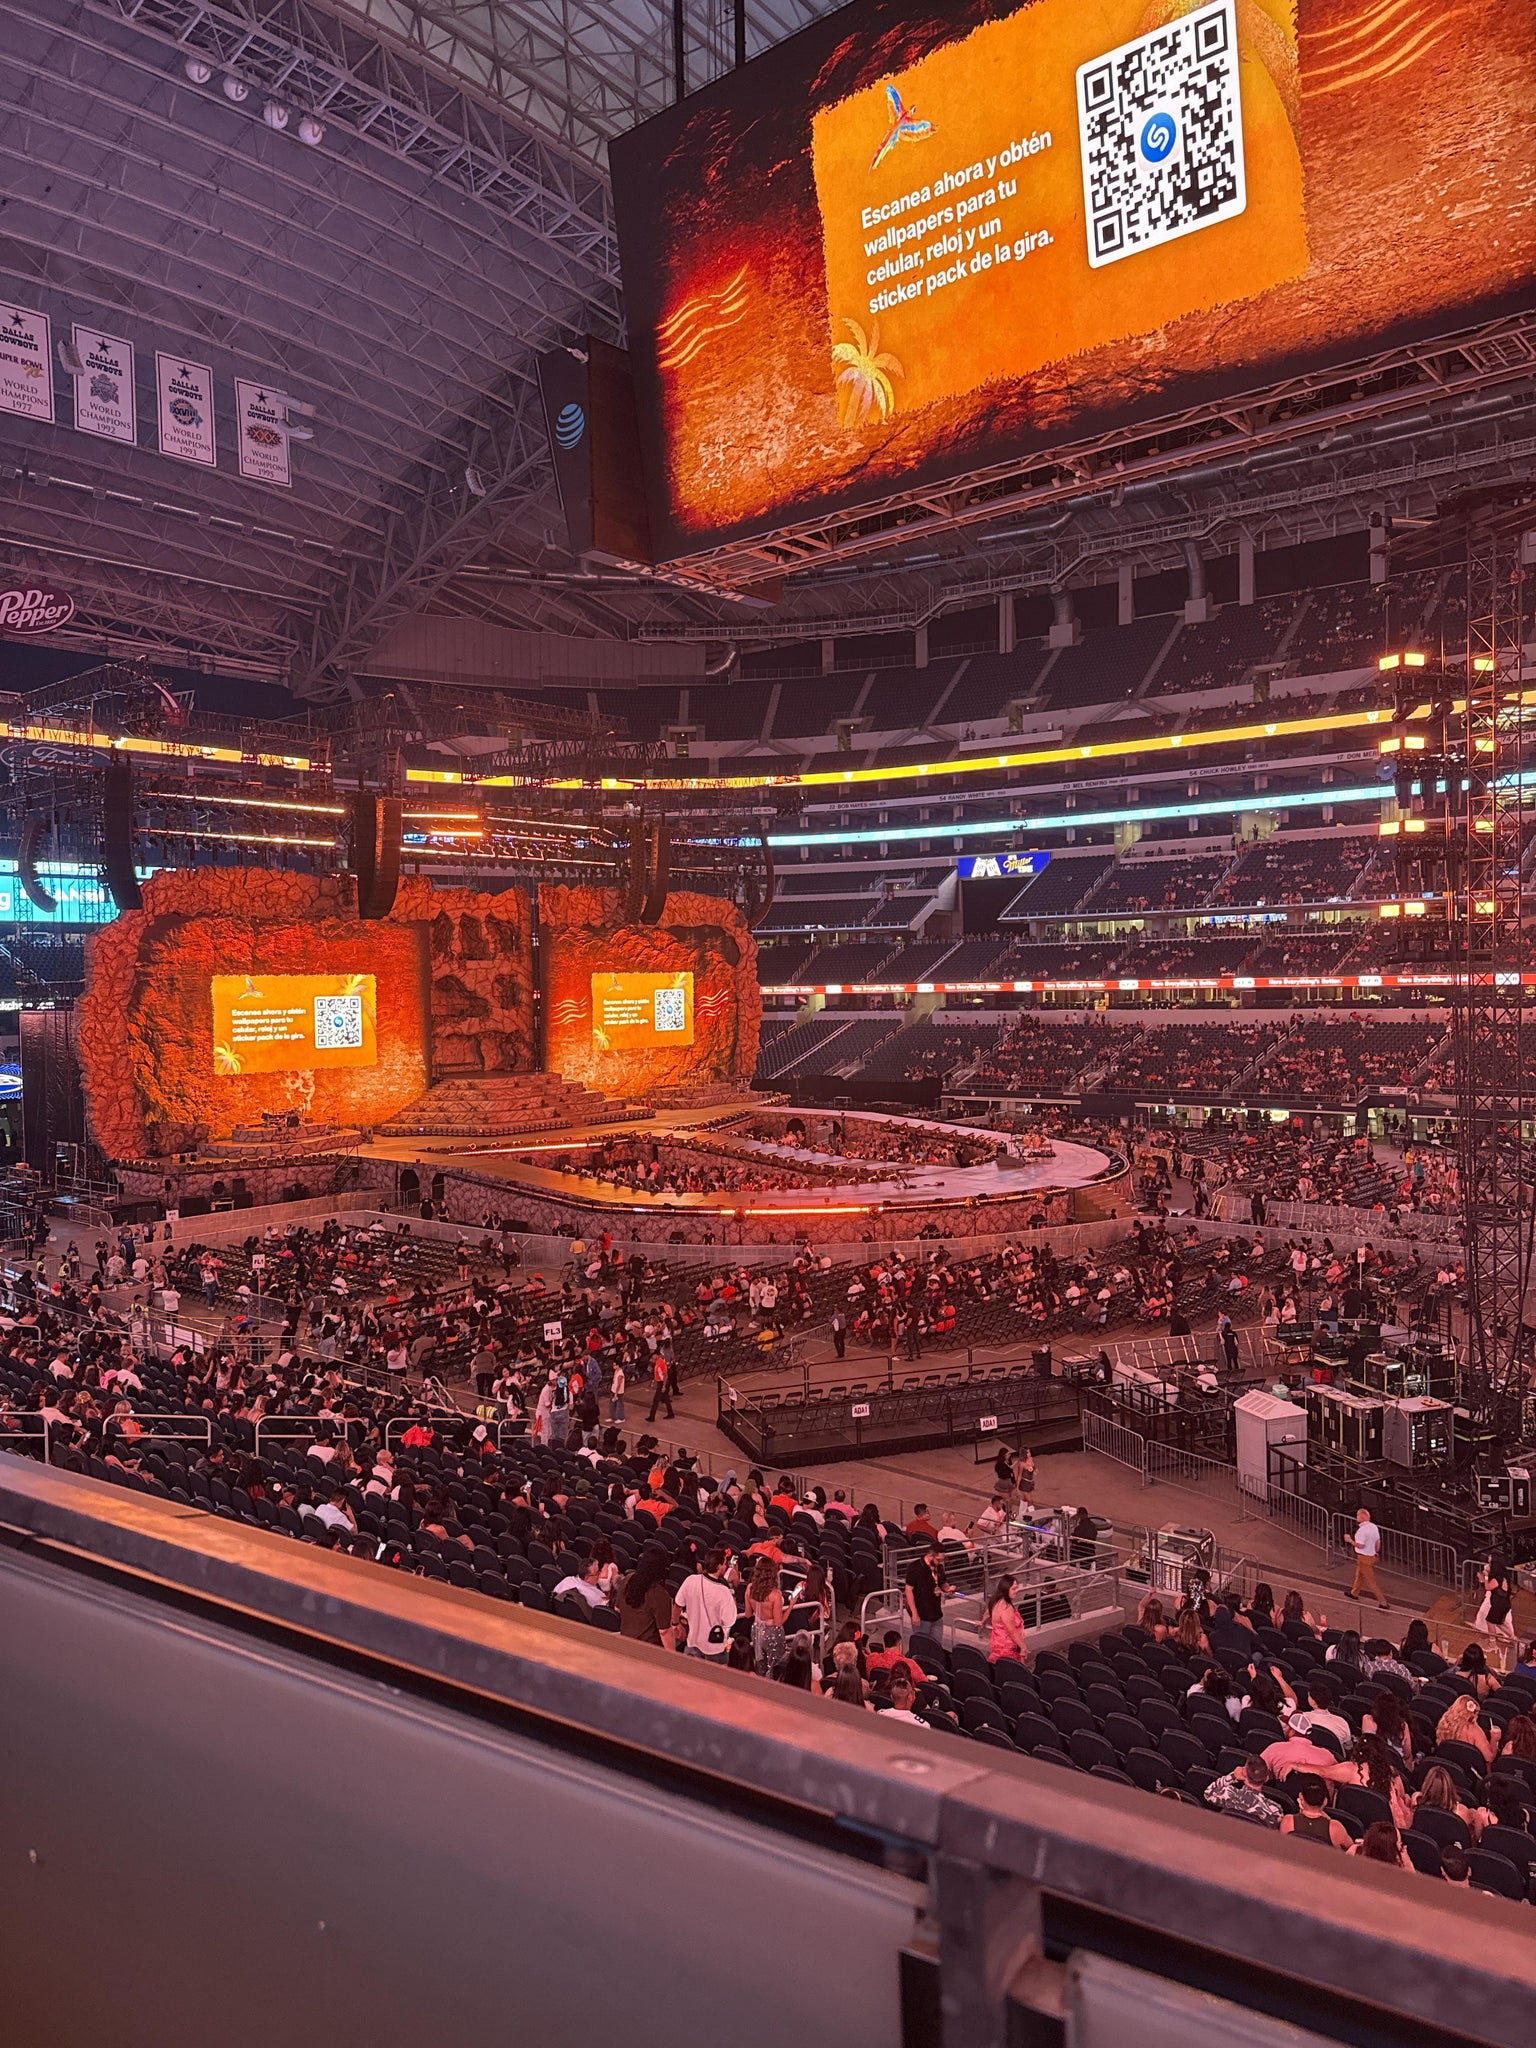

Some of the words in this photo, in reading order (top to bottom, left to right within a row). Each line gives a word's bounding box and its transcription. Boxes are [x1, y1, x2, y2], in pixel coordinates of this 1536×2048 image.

[861, 186, 931, 229] Escanea
[934, 162, 984, 197] ahora
[986, 155, 997, 178] y
[1000, 131, 1052, 167] obtén
[864, 206, 954, 257] wallpapers
[956, 188, 996, 222] para
[998, 178, 1017, 200] tu
[866, 251, 924, 286] celular,
[926, 229, 963, 262] reloj
[965, 227, 976, 250] y
[979, 217, 1002, 240] un
[869, 278, 923, 314] sticker
[926, 259, 968, 296] pack
[970, 251, 992, 273] de
[994, 244, 1011, 265] la
[1013, 229, 1055, 261] gira.
[2, 326, 34, 341] DALLAS
[0, 352, 19, 364] UPER
[21, 358, 44, 370] BOWL
[89, 352, 118, 367] DALLAS
[86, 360, 122, 376] COWBOYS
[4, 378, 38, 394] WORLD
[172, 378, 199, 392] DALLAS
[0, 387, 49, 406] HAMPIONS
[168, 386, 202, 401] COWBOYS
[12, 400, 32, 412] 1977
[89, 402, 121, 417] WORLD
[250, 404, 275, 416] DALLAS
[80, 408, 131, 429] CHAMPIONS
[97, 423, 116, 434] 1992
[172, 426, 202, 440] WORLD
[164, 433, 211, 452] CHAMPIONS
[180, 447, 196, 457] 1993
[252, 450, 278, 462] WORLD
[244, 456, 286, 473] CHAMPIONS
[258, 468, 274, 478] 1995
[22, 590, 54, 610] Dr
[0, 591, 68, 628] Pepper
[1220, 765, 1246, 773] HOWLEY
[545, 1328, 560, 1336] FL3
[854, 1406, 868, 1414] ADA1
[982, 1420, 996, 1428] ADA1
